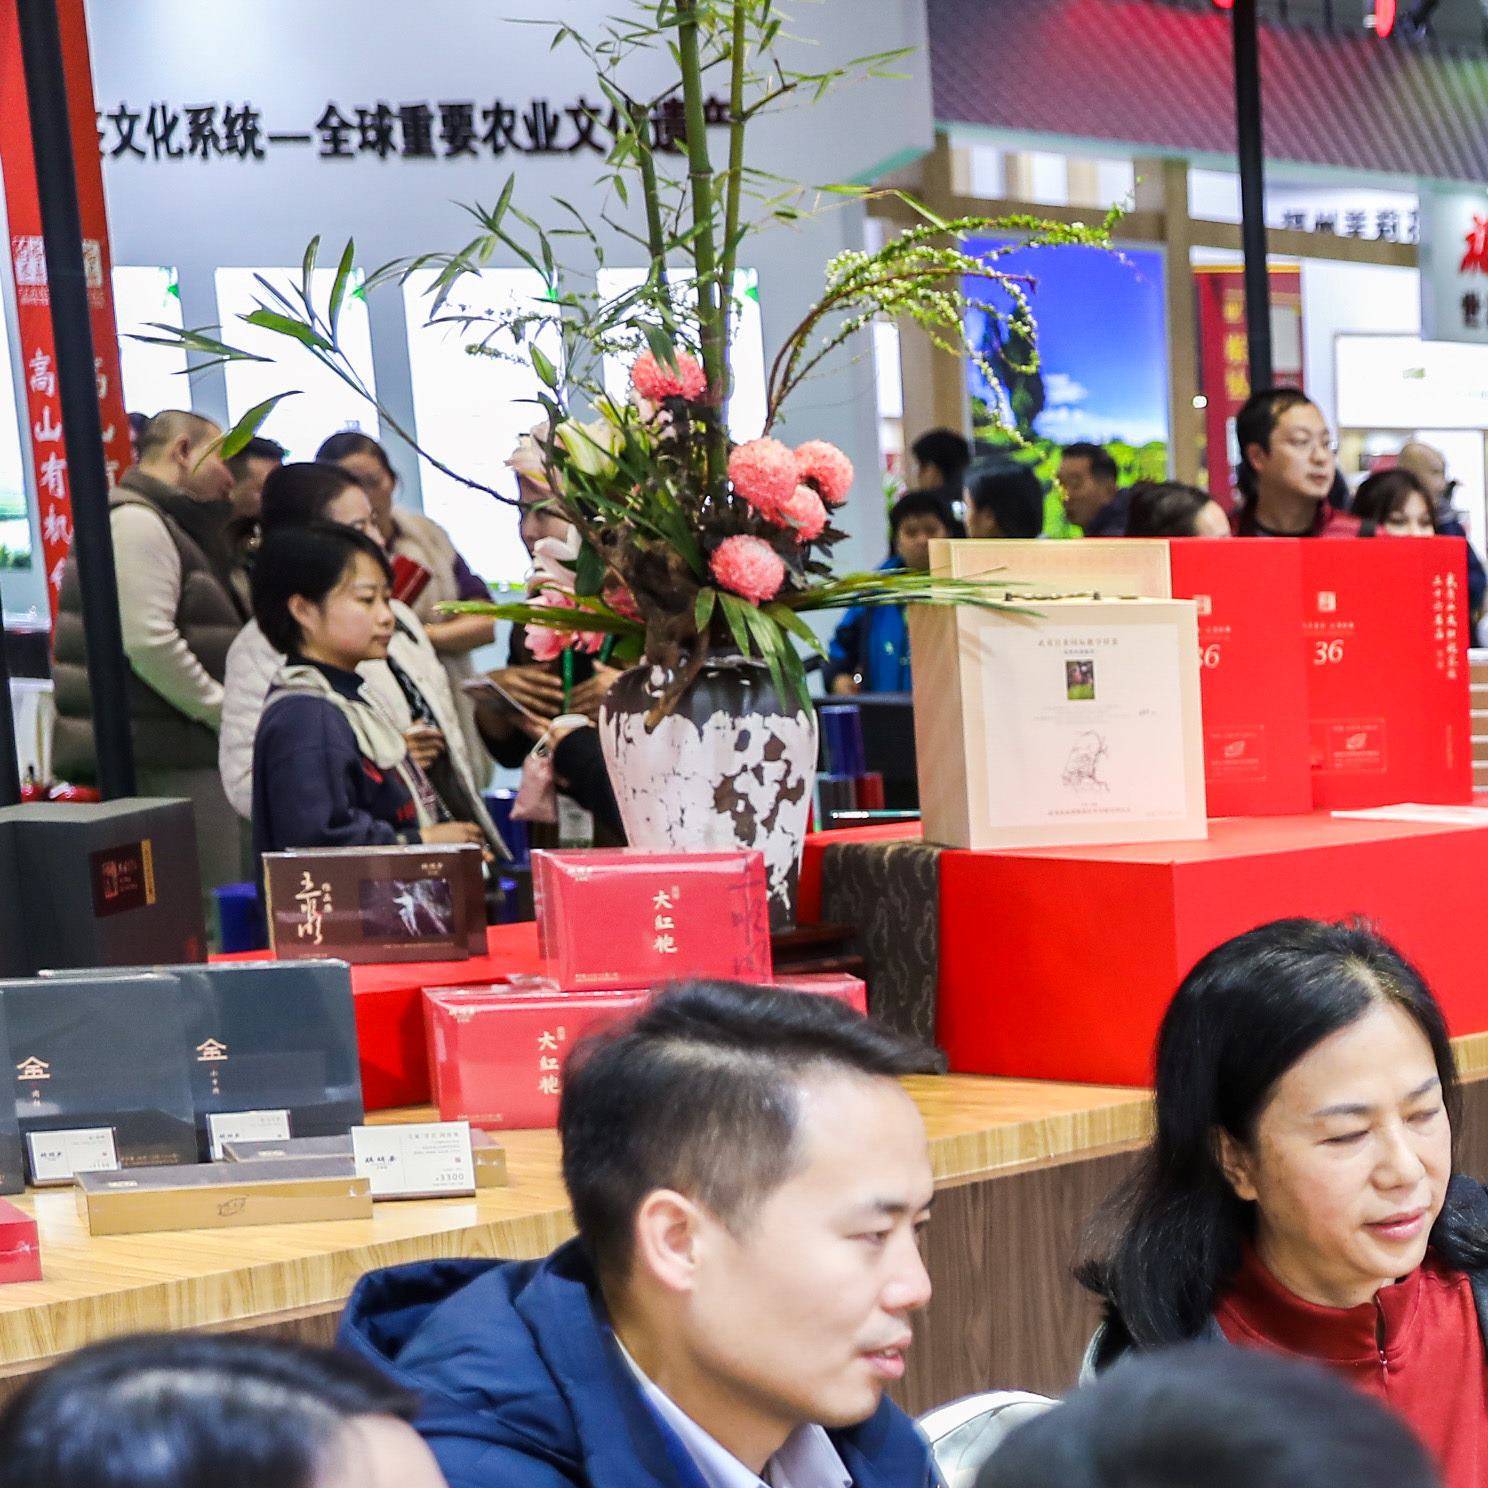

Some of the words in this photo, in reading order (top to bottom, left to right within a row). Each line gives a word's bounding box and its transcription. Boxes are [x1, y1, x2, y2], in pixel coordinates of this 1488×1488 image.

[1313, 640, 1345, 666] 36
[652, 889, 678, 954] 大红袍
[537, 1030, 561, 1095] 大红袍
